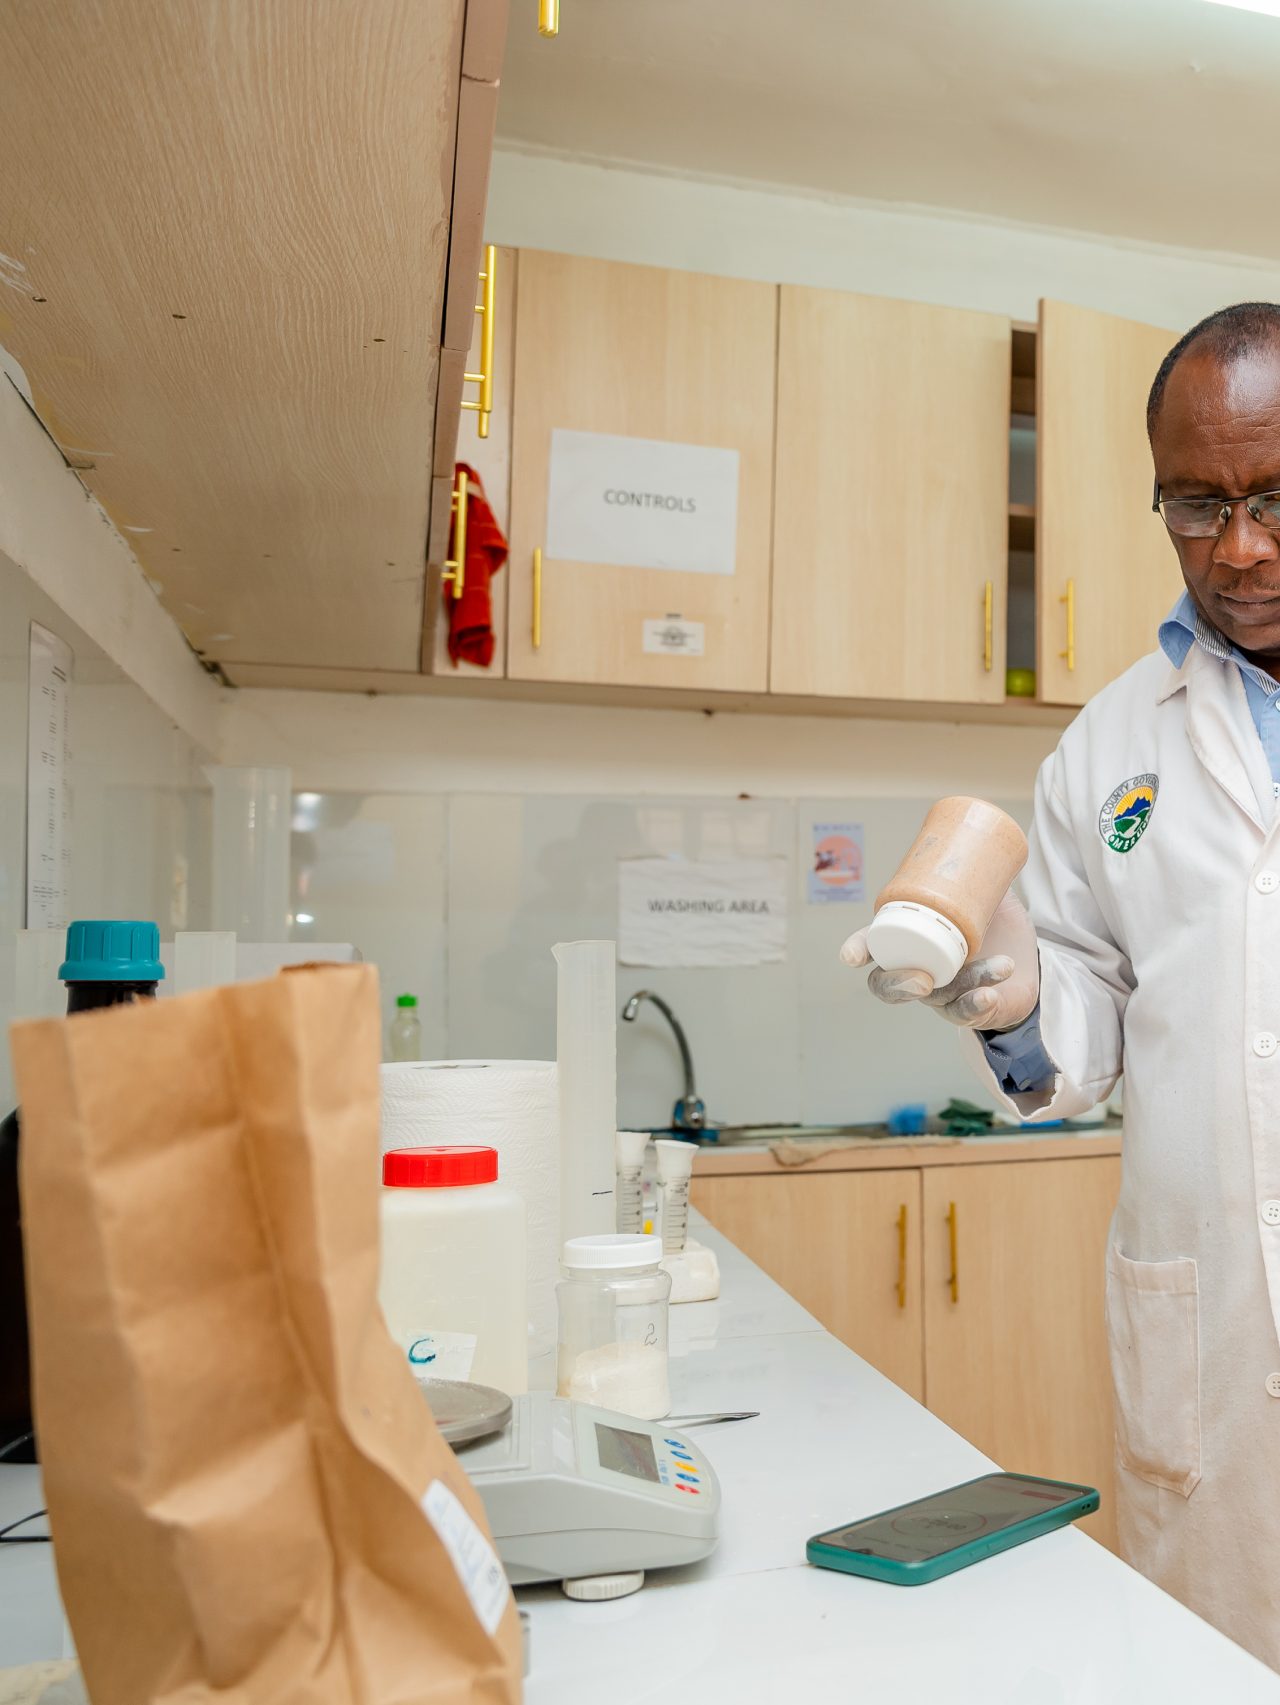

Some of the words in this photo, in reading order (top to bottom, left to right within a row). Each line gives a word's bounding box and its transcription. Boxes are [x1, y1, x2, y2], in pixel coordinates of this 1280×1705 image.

[603, 488, 697, 513] CONTROLS
[1103, 783, 1129, 815] COUNTY
[1101, 818, 1112, 835] THE
[647, 898, 725, 914] WASHING
[728, 898, 771, 915] AREA
